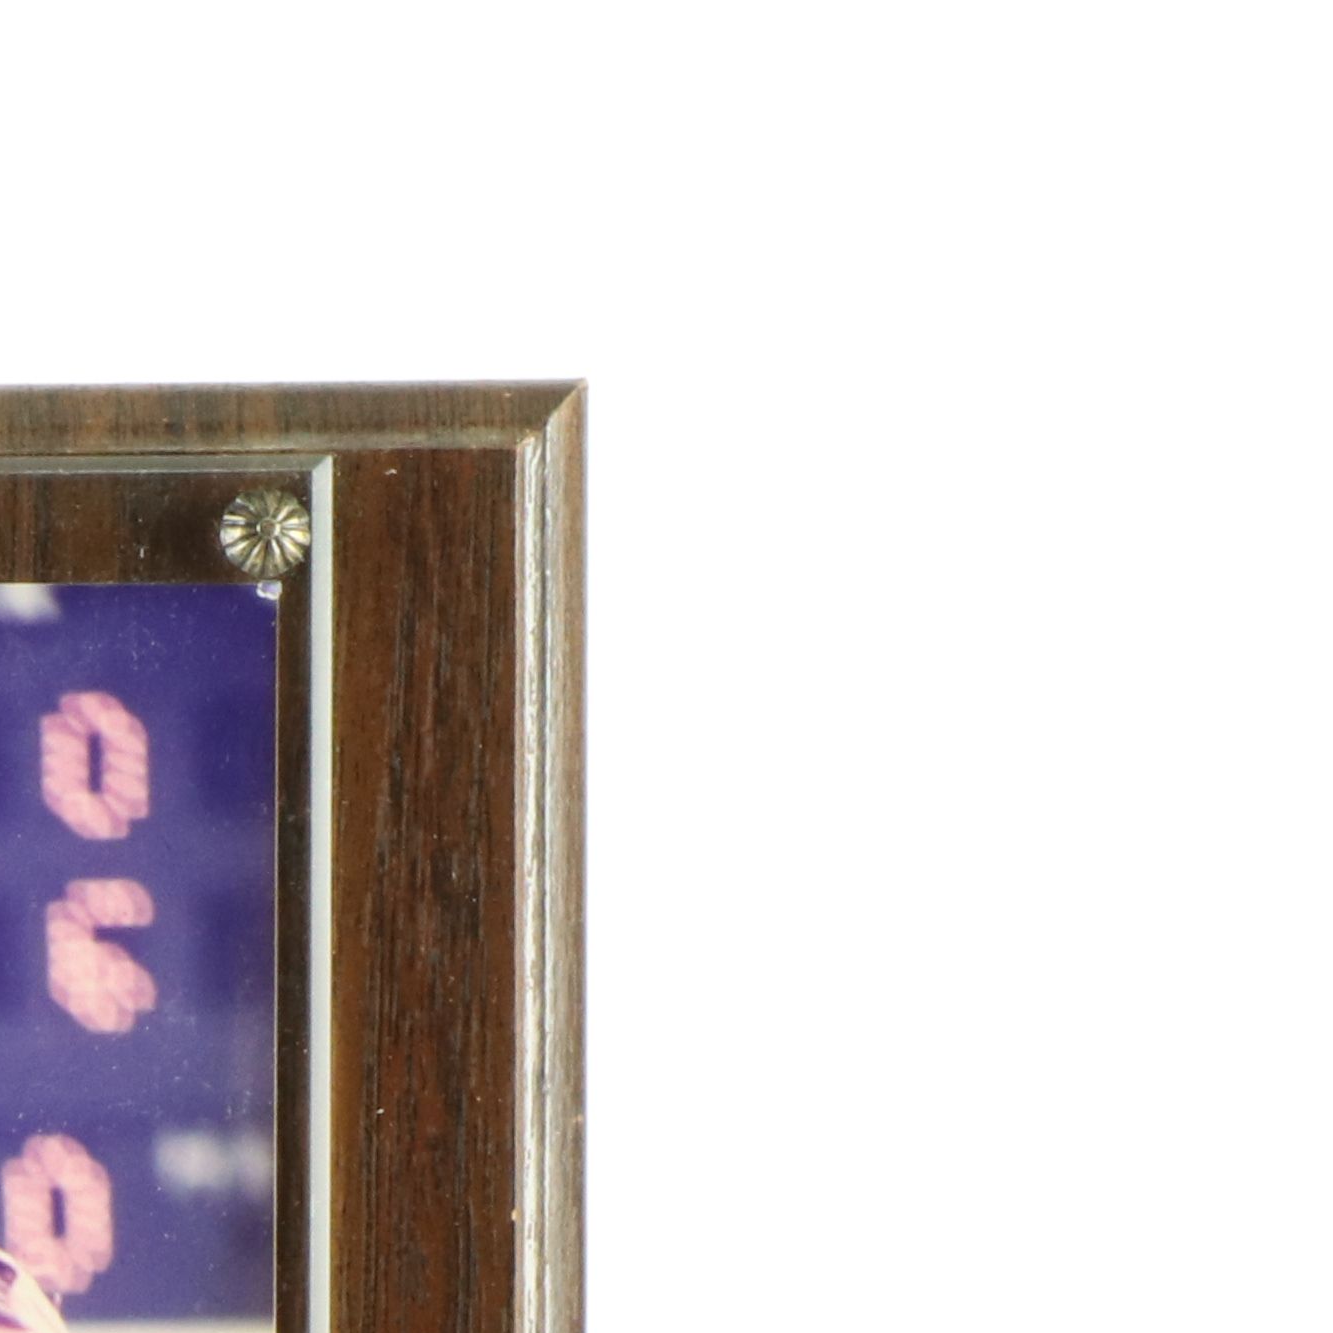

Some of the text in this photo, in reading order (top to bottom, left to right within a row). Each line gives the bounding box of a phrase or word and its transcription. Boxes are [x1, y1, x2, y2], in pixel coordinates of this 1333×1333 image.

[40, 691, 149, 839] 0
[47, 879, 157, 1033] 6
[2, 1135, 114, 1292] 0
